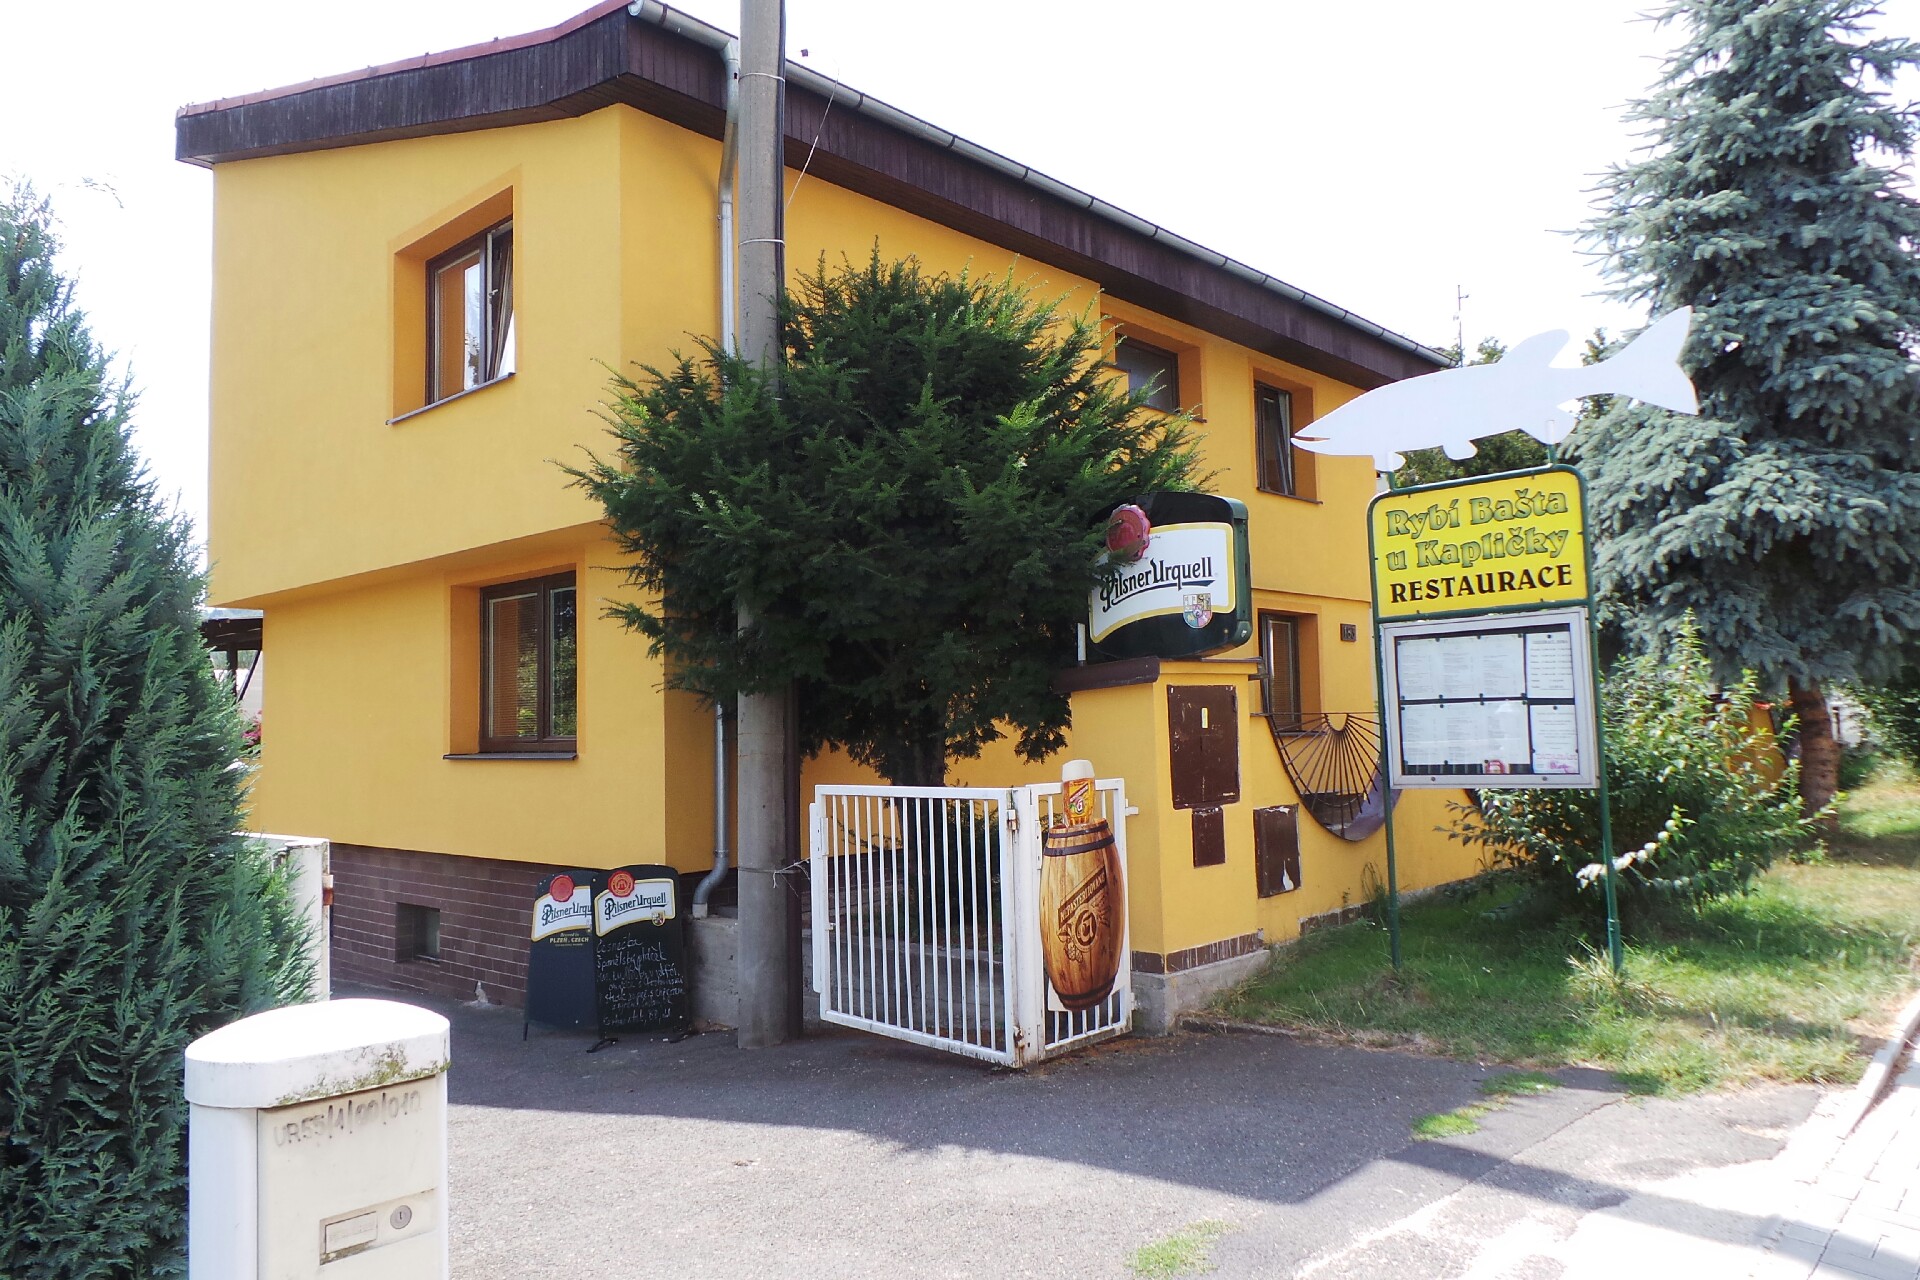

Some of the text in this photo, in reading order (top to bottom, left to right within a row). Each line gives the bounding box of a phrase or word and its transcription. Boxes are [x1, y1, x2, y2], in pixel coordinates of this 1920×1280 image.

[1386, 488, 1568, 539] Rybí Bašta
[1386, 527, 1569, 571] u Kapličky
[1100, 556, 1213, 613] Pilsner Urquell
[1390, 564, 1572, 603] RESTAURACE
[541, 904, 572, 926] Pilsner
[605, 892, 666, 920] Pilsner Urquell
